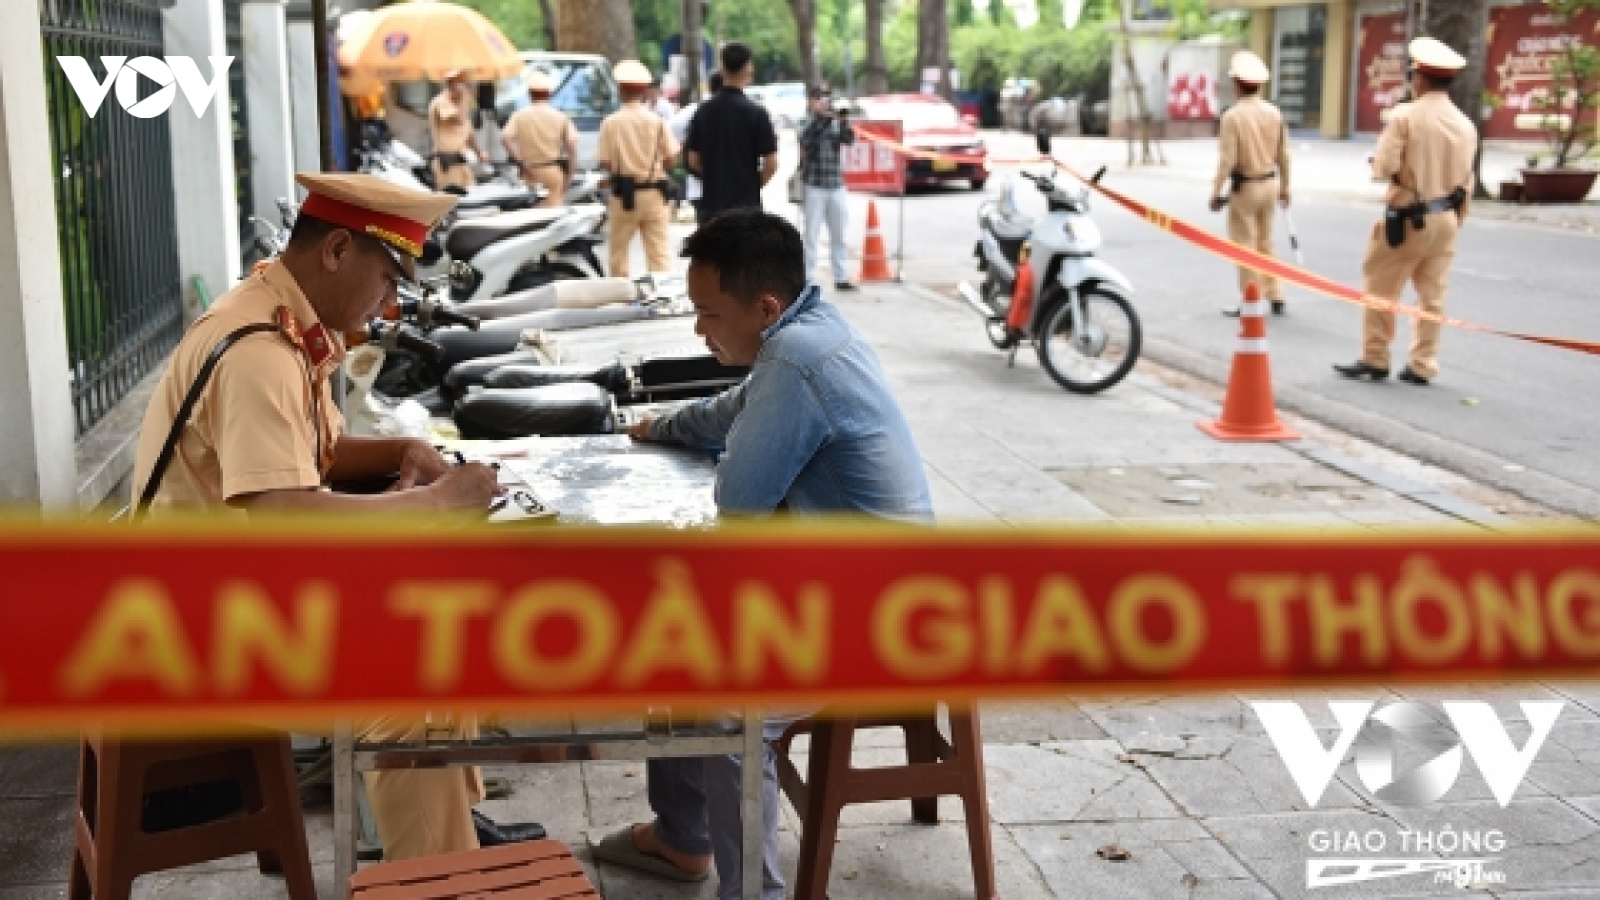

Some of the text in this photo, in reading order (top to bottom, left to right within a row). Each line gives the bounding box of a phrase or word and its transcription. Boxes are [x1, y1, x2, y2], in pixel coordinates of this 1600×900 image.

[58, 576, 338, 694] AN
[388, 558, 830, 691] TOÀN
[870, 573, 1207, 680] GIAO
